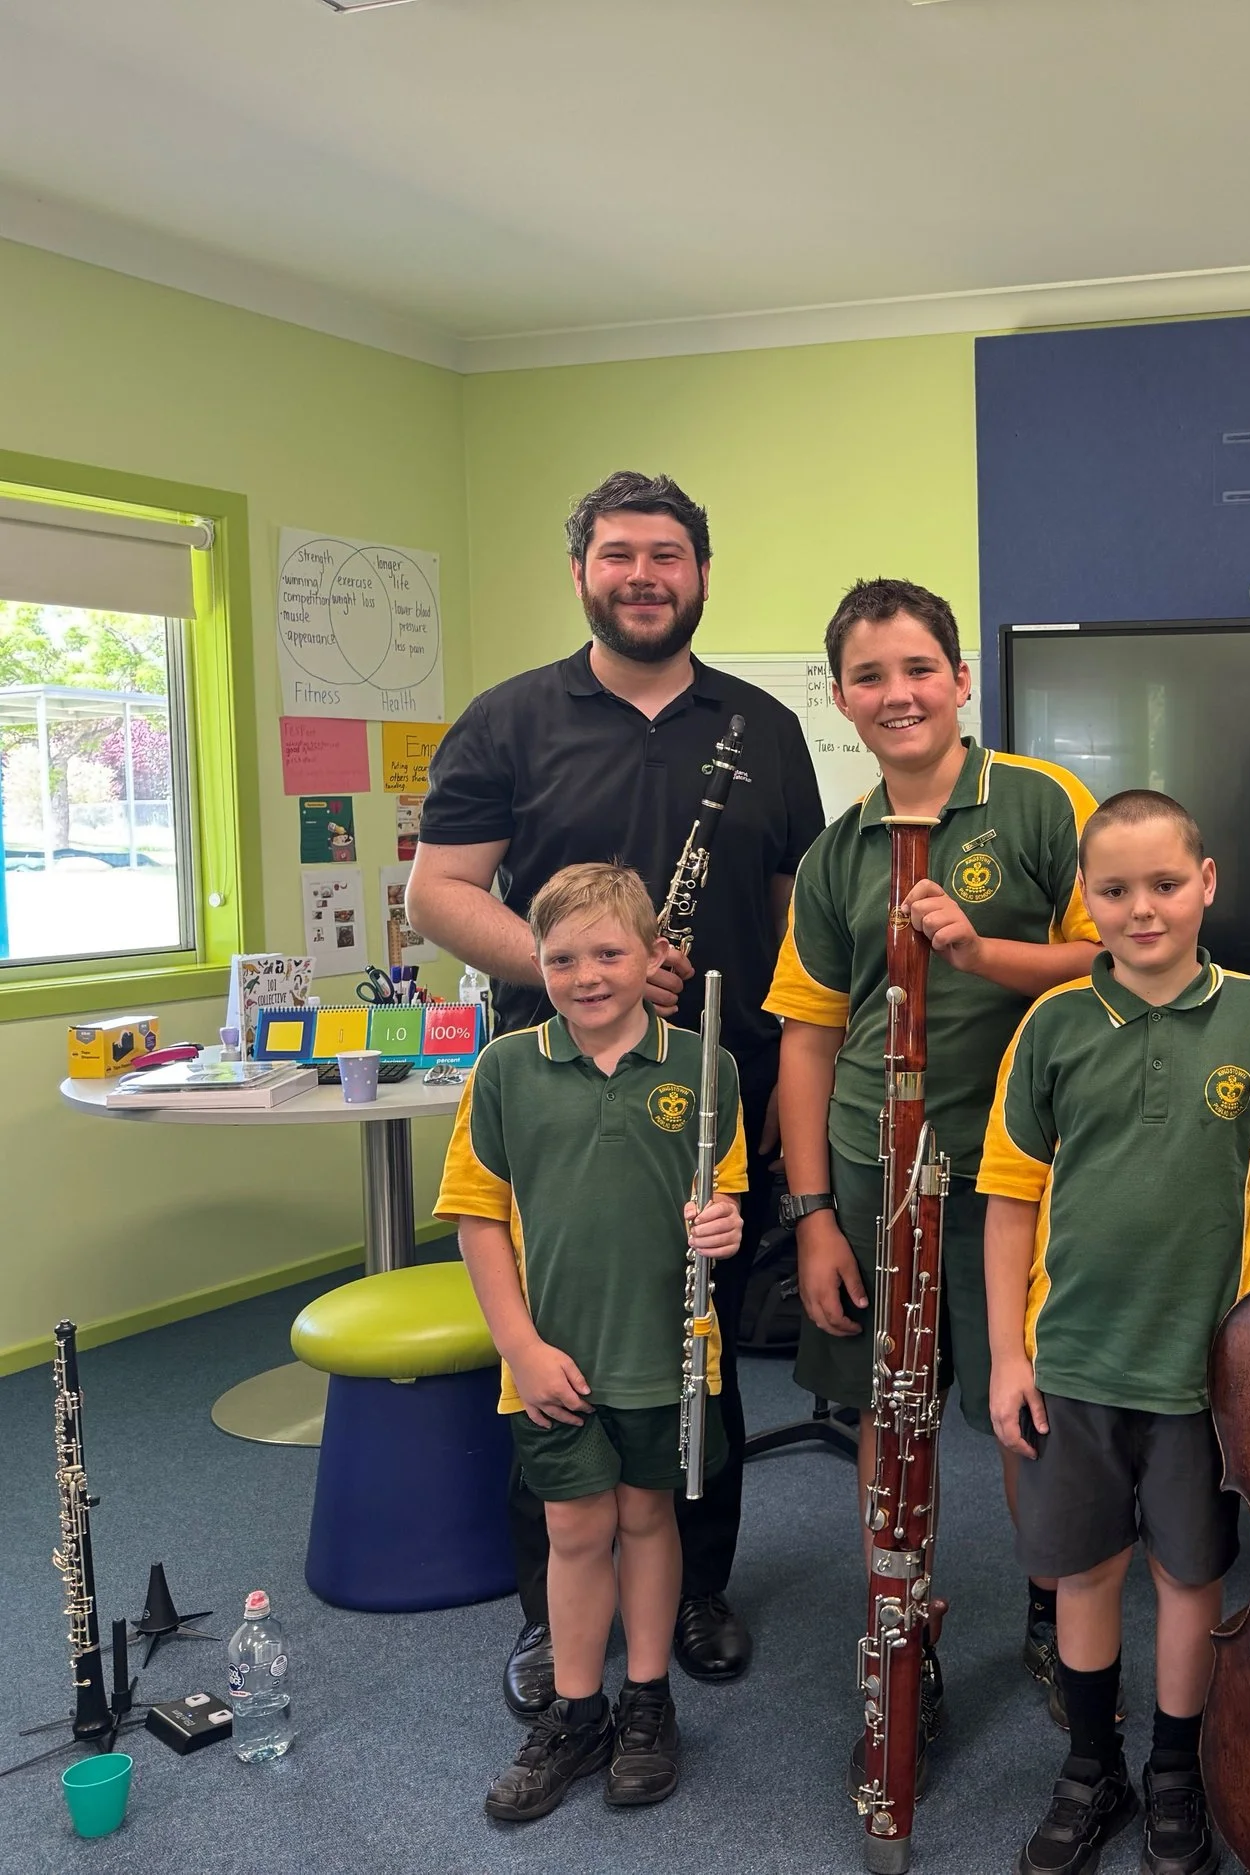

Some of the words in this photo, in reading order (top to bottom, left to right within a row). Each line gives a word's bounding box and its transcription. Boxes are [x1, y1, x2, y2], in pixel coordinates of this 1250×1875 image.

[377, 554, 402, 578] longer
[337, 576, 373, 589] exercise
[393, 574, 410, 591] life
[362, 592, 375, 608] loss
[283, 610, 311, 623] muscle
[415, 601, 431, 618] blood
[399, 622, 427, 637] pressure
[287, 630, 336, 648] appearance
[295, 681, 341, 704] Fitness
[808, 682, 825, 691] CW:
[381, 689, 417, 712] Health
[808, 697, 823, 707] JS:
[406, 735, 438, 760] Emp
[815, 739, 835, 753] Tues
[257, 993, 287, 1007] COLLECTIVE
[386, 1027, 407, 1041] 1.0
[430, 1025, 471, 1041] 100%
